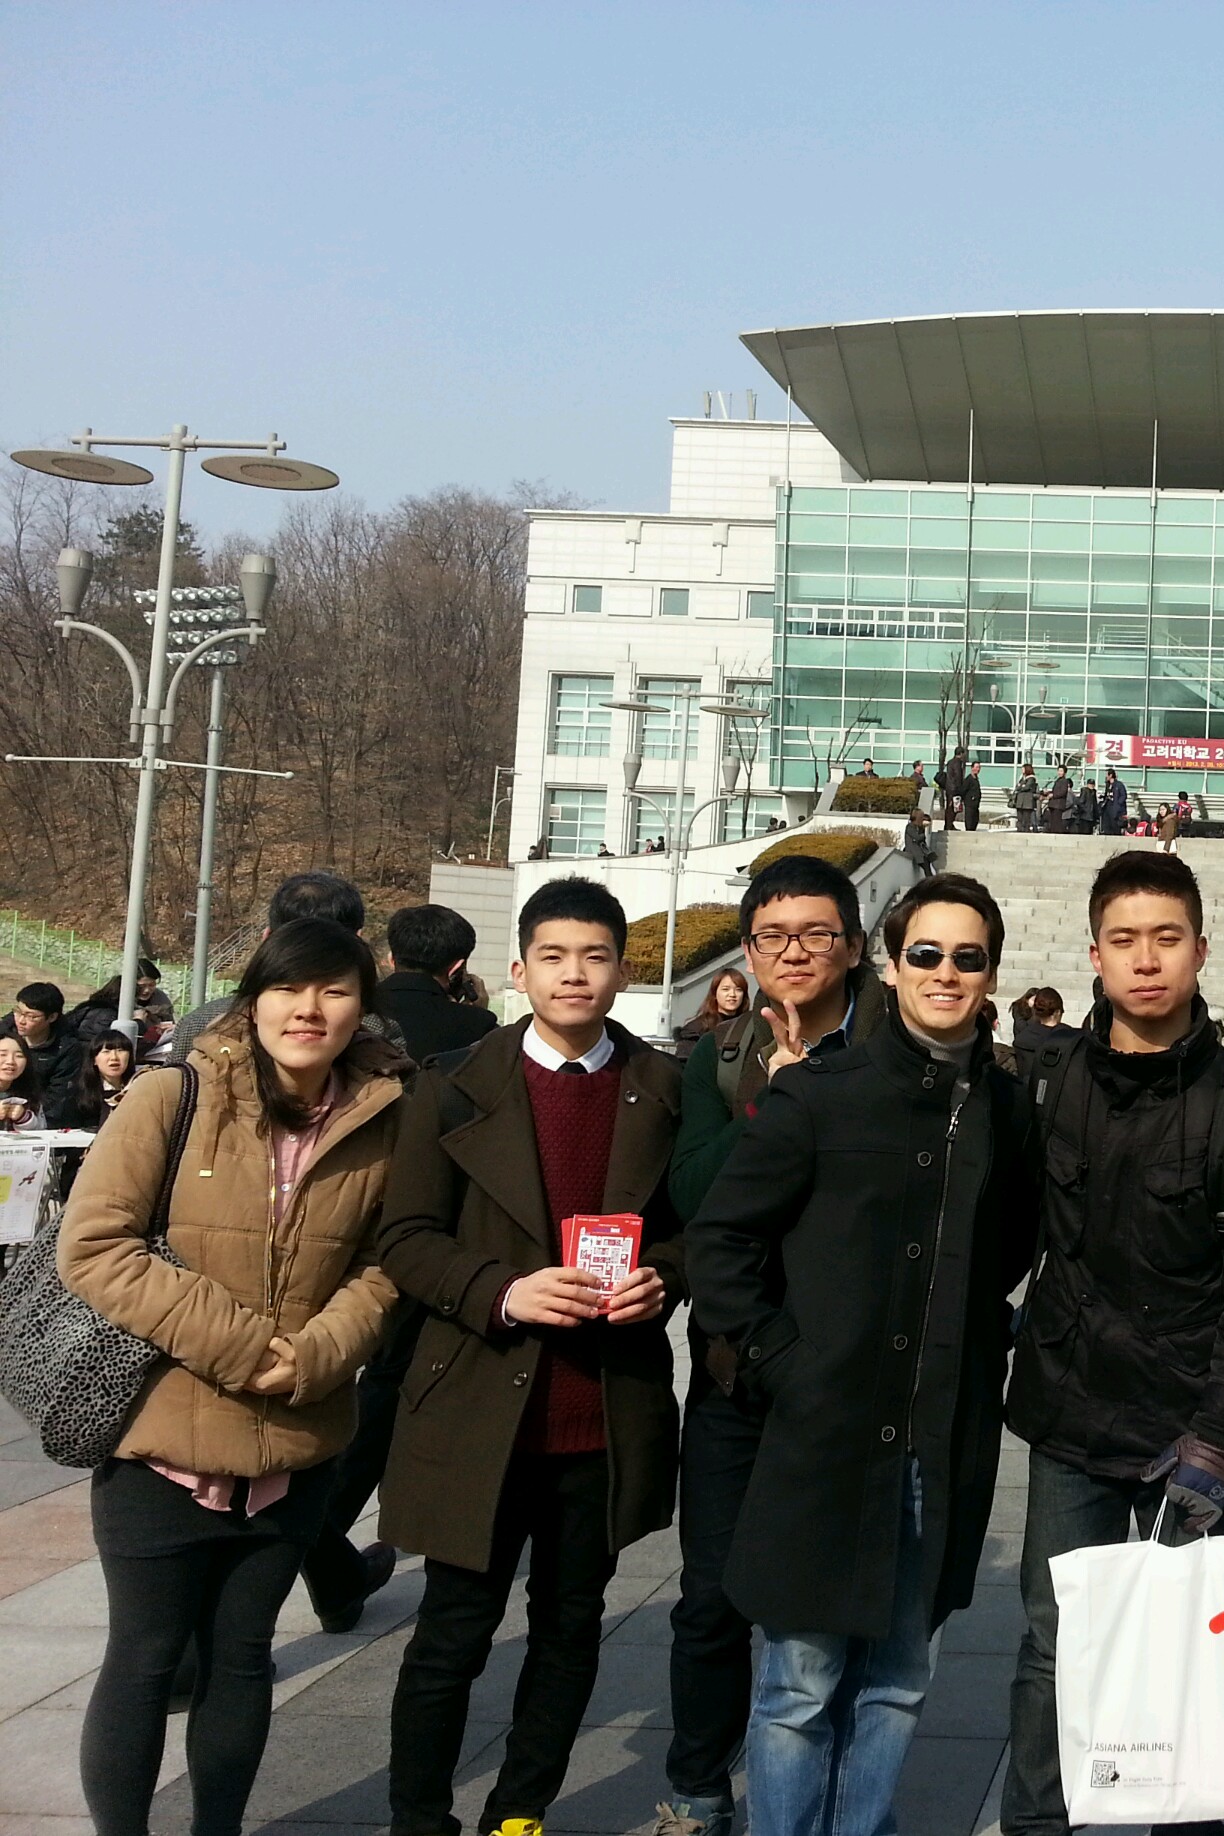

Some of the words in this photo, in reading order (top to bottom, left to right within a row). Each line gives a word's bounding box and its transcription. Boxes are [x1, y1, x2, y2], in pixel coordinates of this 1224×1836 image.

[1142, 745, 1210, 760] 고려대학교
[1094, 1742, 1127, 1753] ASIANA
[1130, 1742, 1174, 1752] AIRLINES
